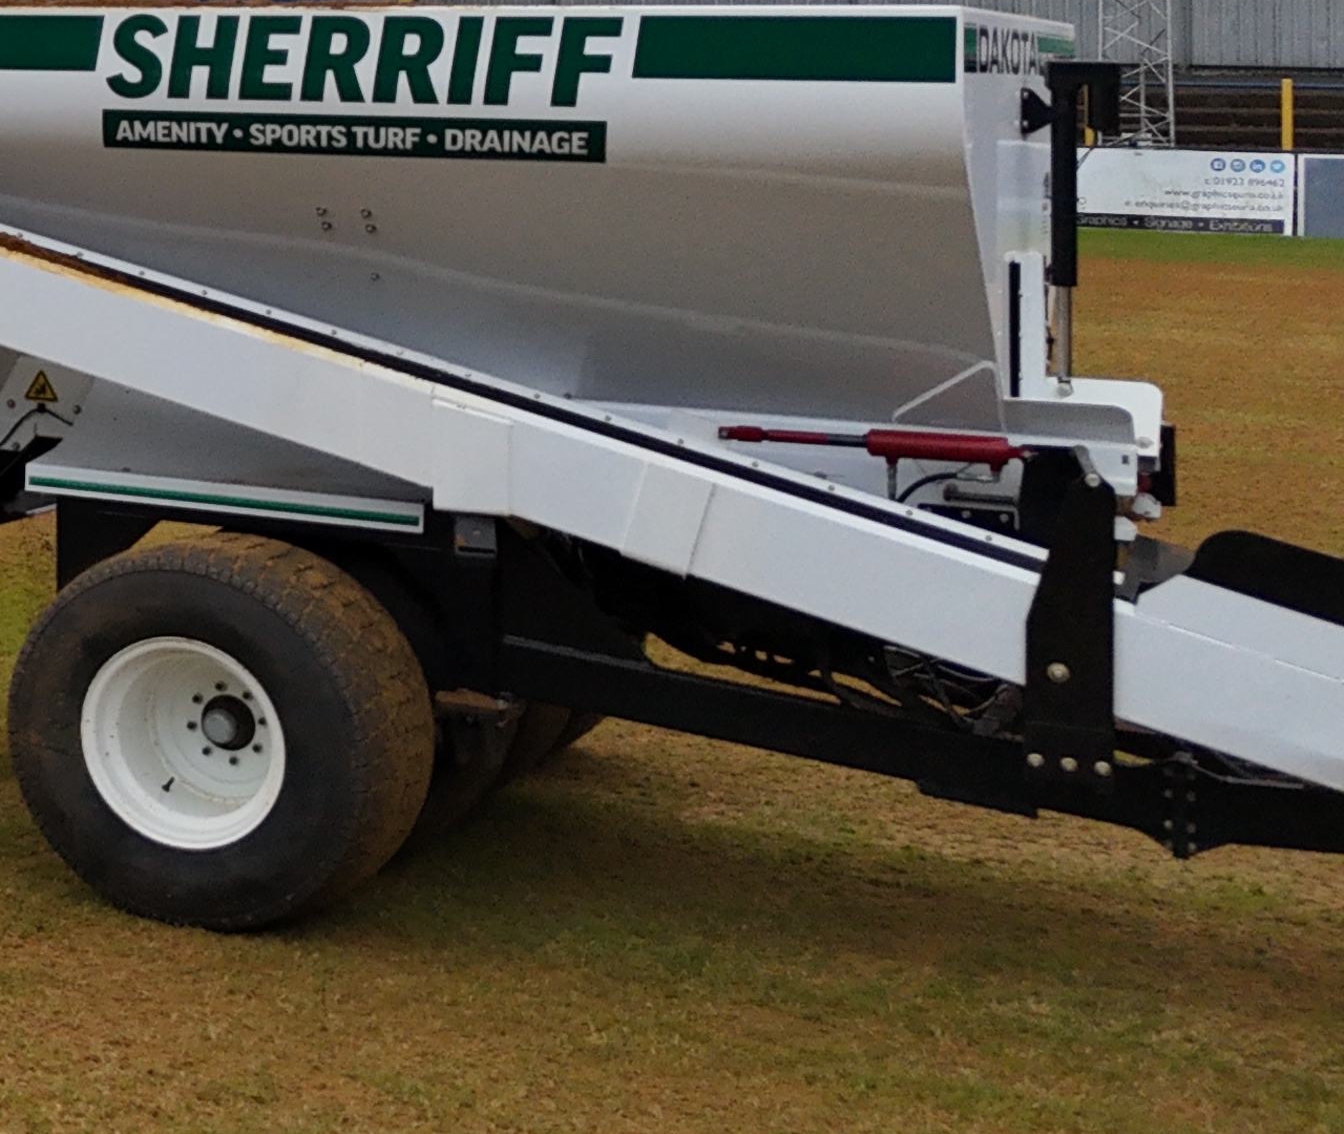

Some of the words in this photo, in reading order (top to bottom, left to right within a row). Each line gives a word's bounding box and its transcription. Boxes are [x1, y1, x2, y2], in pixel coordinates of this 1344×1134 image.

[105, 13, 624, 107] SHERRIFF
[979, 25, 1039, 75] DAKOTA
[115, 119, 230, 144] AMENITY
[249, 122, 348, 149] SPORTS
[351, 125, 422, 151] TURF
[444, 127, 589, 155] DRAINAGE
